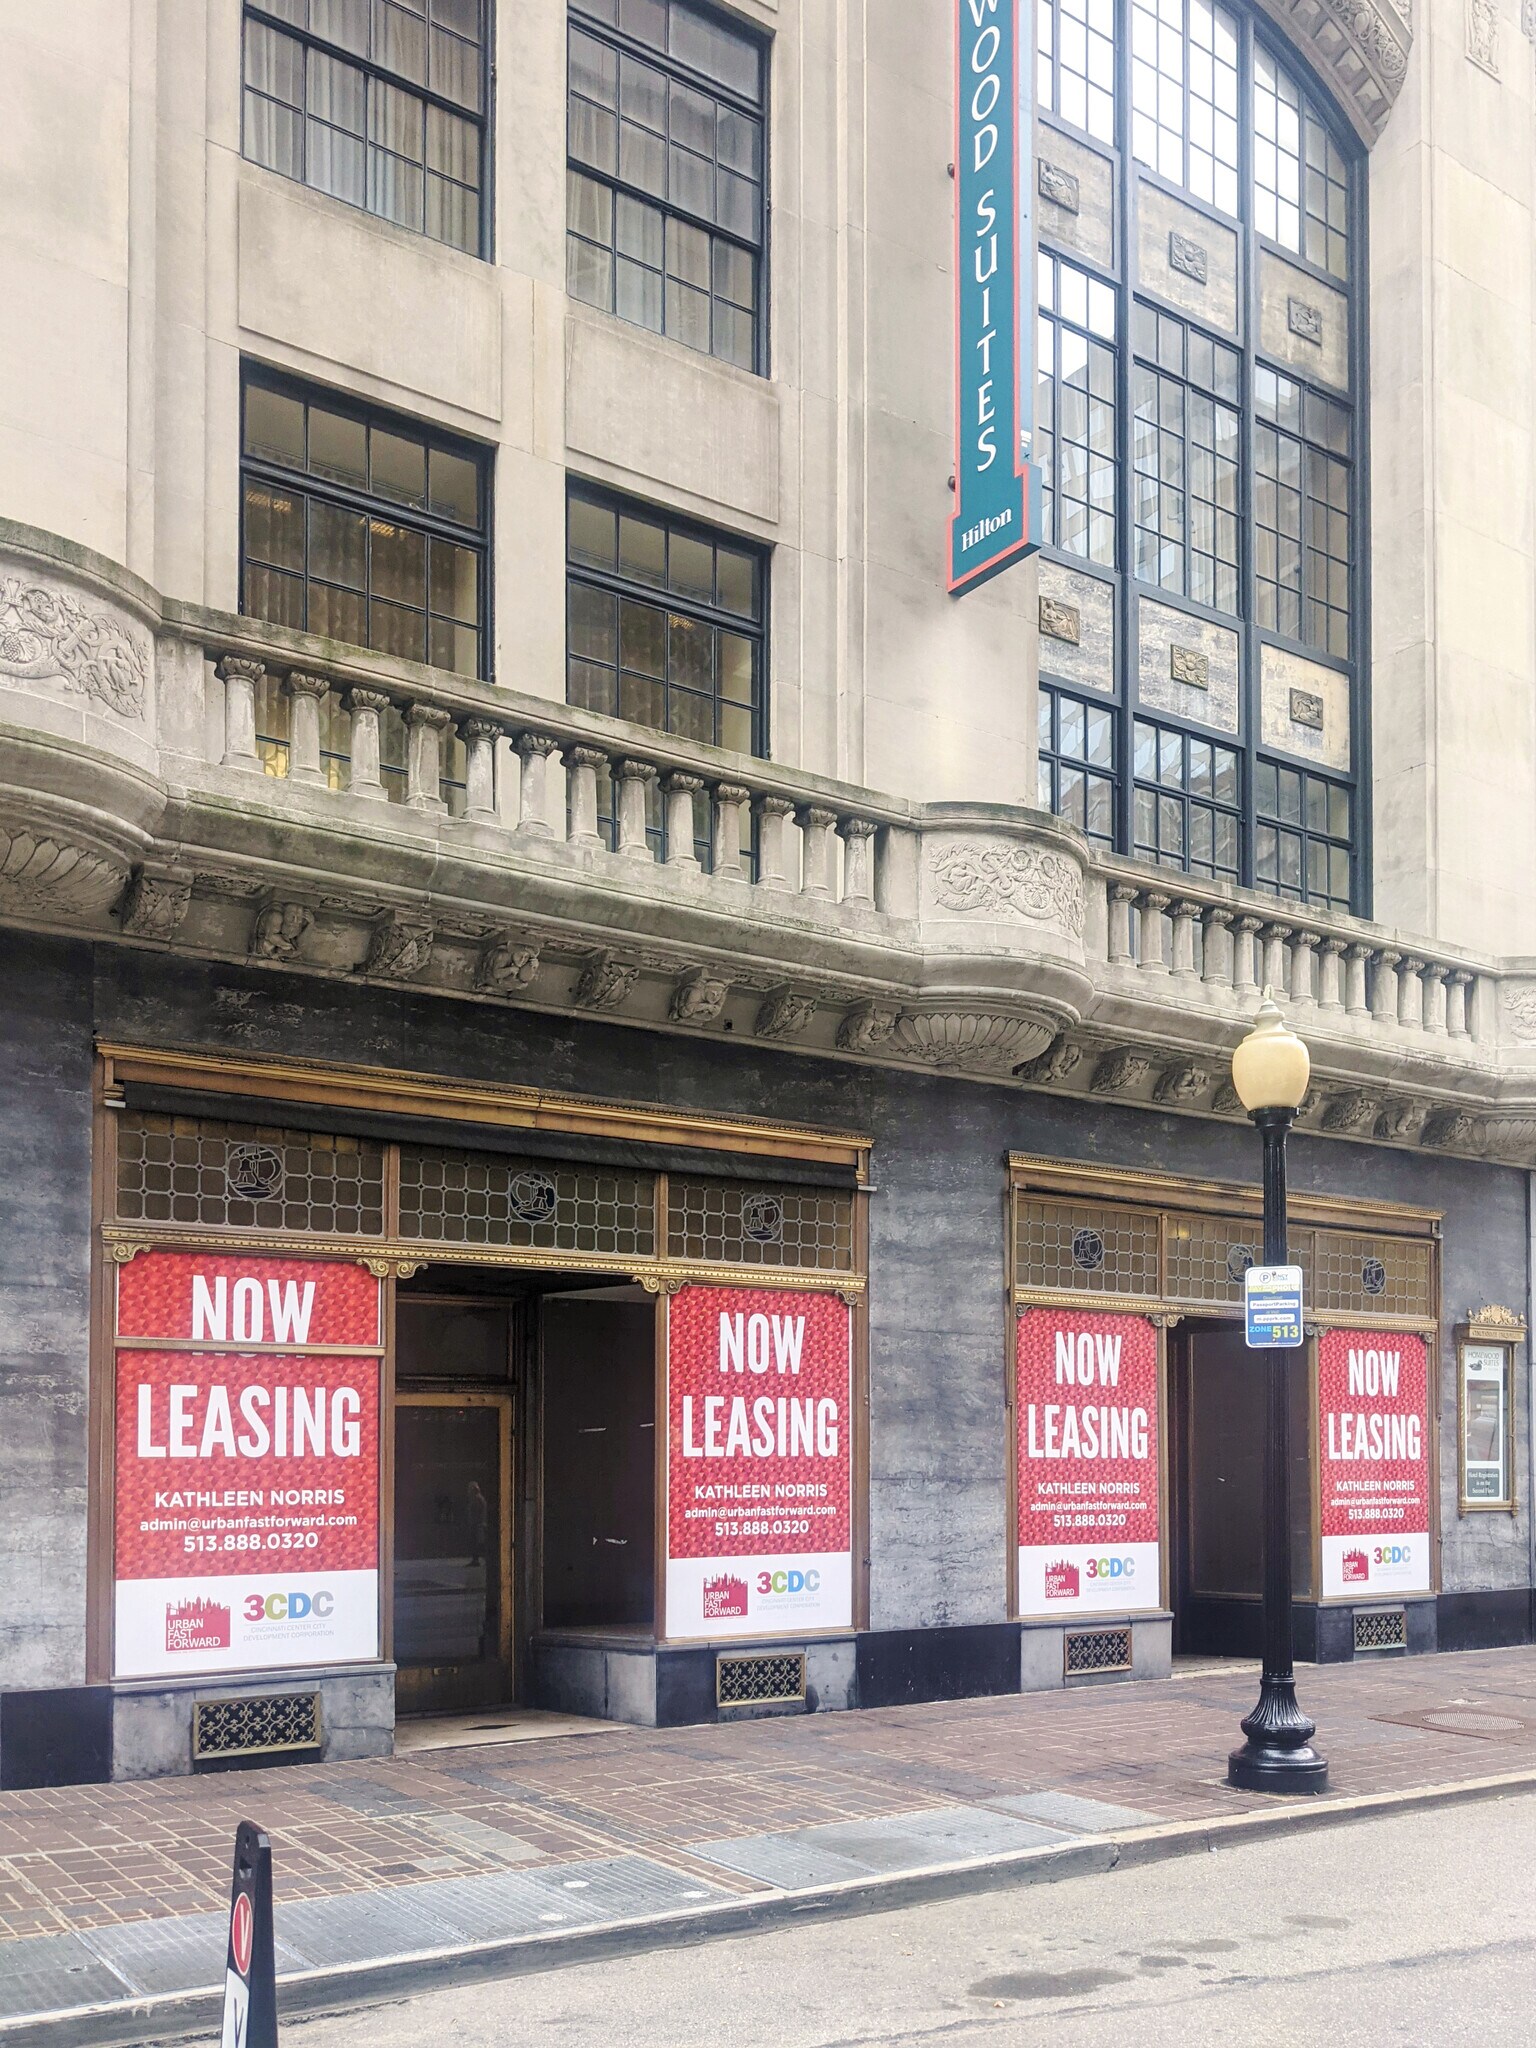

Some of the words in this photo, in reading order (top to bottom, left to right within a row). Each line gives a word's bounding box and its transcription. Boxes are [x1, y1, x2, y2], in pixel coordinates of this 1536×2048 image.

[974, 189, 999, 472] SUITES
[961, 508, 1012, 553] Hilton
[192, 1275, 316, 1358] NOW
[1272, 1325, 1299, 1338] 513
[719, 1312, 806, 1374] NOW
[1055, 1331, 1122, 1386] NOW
[1467, 1351, 1500, 1360] HOMEWOOD
[1483, 1359, 1500, 1367] SUITES
[1348, 1349, 1400, 1397] NOW
[138, 1384, 361, 1457] LEASING
[682, 1395, 838, 1457] LEASING
[1028, 1404, 1148, 1459] LEASING
[1328, 1412, 1421, 1460] LEASING
[694, 1484, 771, 1499] KATHLEEN
[775, 1484, 828, 1497] NORRIS
[1037, 1482, 1097, 1494] KATHLEEN
[1099, 1482, 1140, 1494] NORRIS
[1336, 1481, 1381, 1491] KATHLEEN
[1383, 1480, 1415, 1490] NORRIS
[155, 1490, 263, 1507] KATHLEEN
[271, 1489, 345, 1505] NORRIS
[1030, 1500, 1147, 1512] admin@urbanfastforward.com
[685, 1505, 837, 1520] admin@urbanfastforward.com
[1053, 1514, 1126, 1527] 513.888.0320
[1348, 1507, 1404, 1520] 513.888.0320
[140, 1514, 358, 1532] admin@urbanfastforward.com
[715, 1520, 809, 1536] 513.888.0320
[184, 1532, 319, 1552] 513.888.0320
[1373, 1545, 1411, 1564] 3CDC
[1086, 1557, 1135, 1578] 3CDC
[756, 1569, 821, 1595] 3CDC
[704, 1591, 730, 1600] URBAN
[1046, 1588, 1075, 1597] FORWARD
[243, 1590, 334, 1622] 3CDC
[704, 1599, 723, 1608] FAST
[704, 1606, 742, 1617] FORWARD
[167, 1618, 204, 1630] URBAN
[167, 1629, 193, 1639] FAST
[167, 1636, 221, 1649] FORWARD
